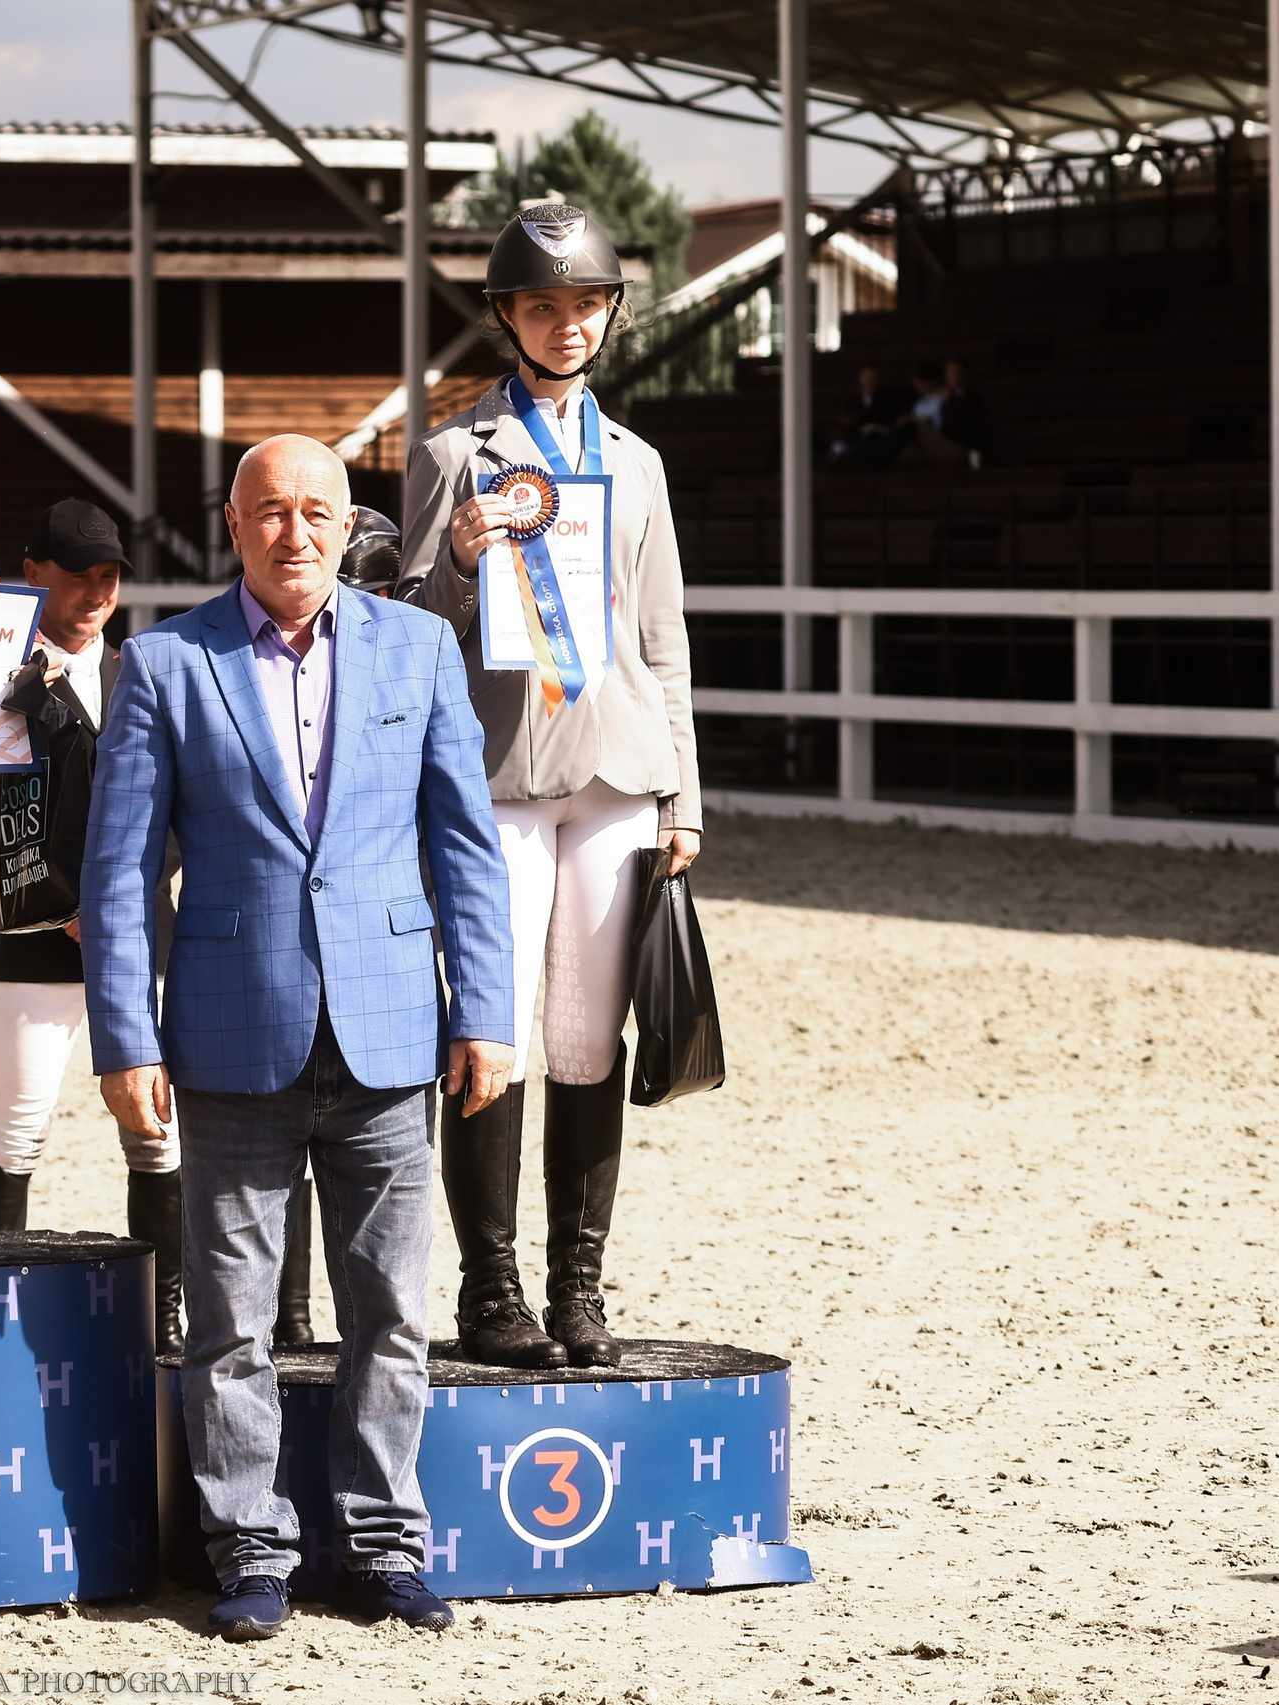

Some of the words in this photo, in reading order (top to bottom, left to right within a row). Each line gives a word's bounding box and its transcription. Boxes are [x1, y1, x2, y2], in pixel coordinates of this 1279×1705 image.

[541, 579, 557, 613] СПОРТ
[552, 615, 573, 665] HORSEKA
[533, 1450, 581, 1527] 3
